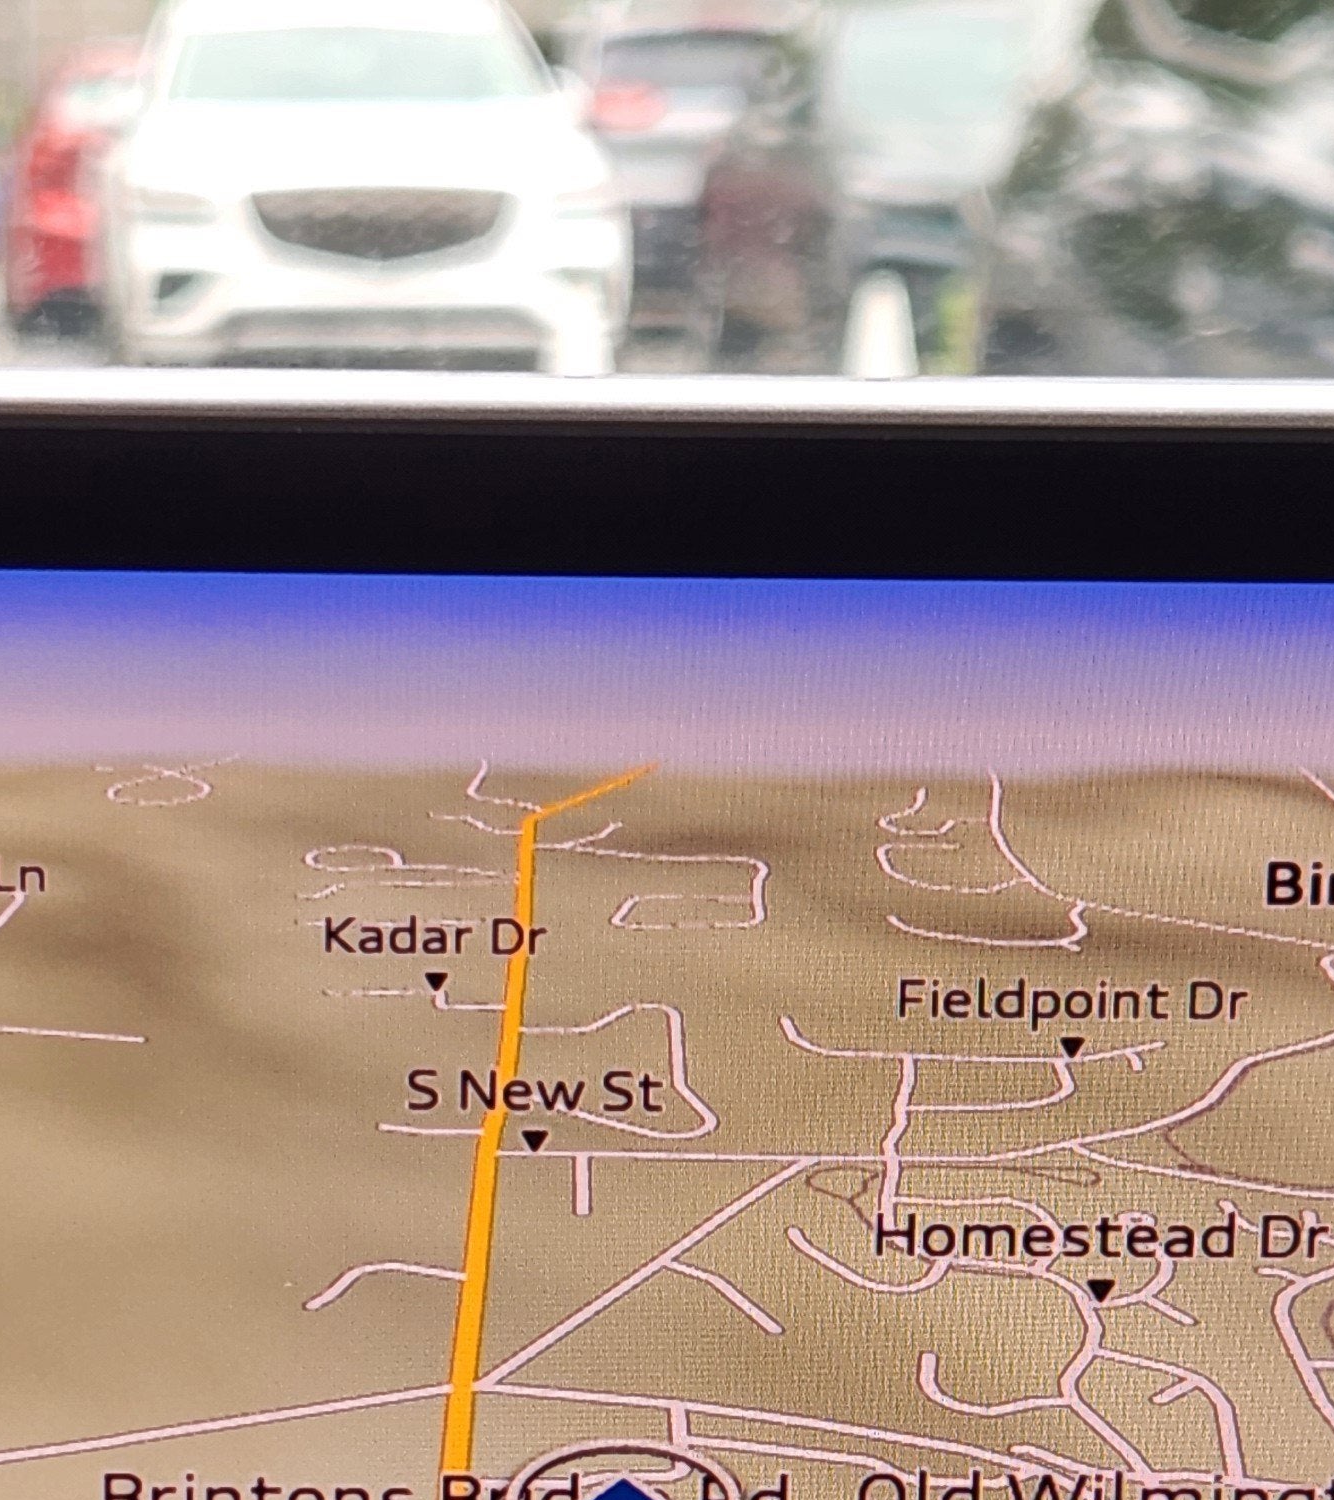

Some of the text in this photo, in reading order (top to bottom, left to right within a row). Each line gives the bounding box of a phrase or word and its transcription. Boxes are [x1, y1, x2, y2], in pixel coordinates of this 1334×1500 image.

[324, 917, 548, 955] Kadar Dr
[897, 978, 1249, 1030] Fieldpoint Dr
[406, 1069, 664, 1113] S New St
[875, 1213, 1330, 1259] Homestead Dr
